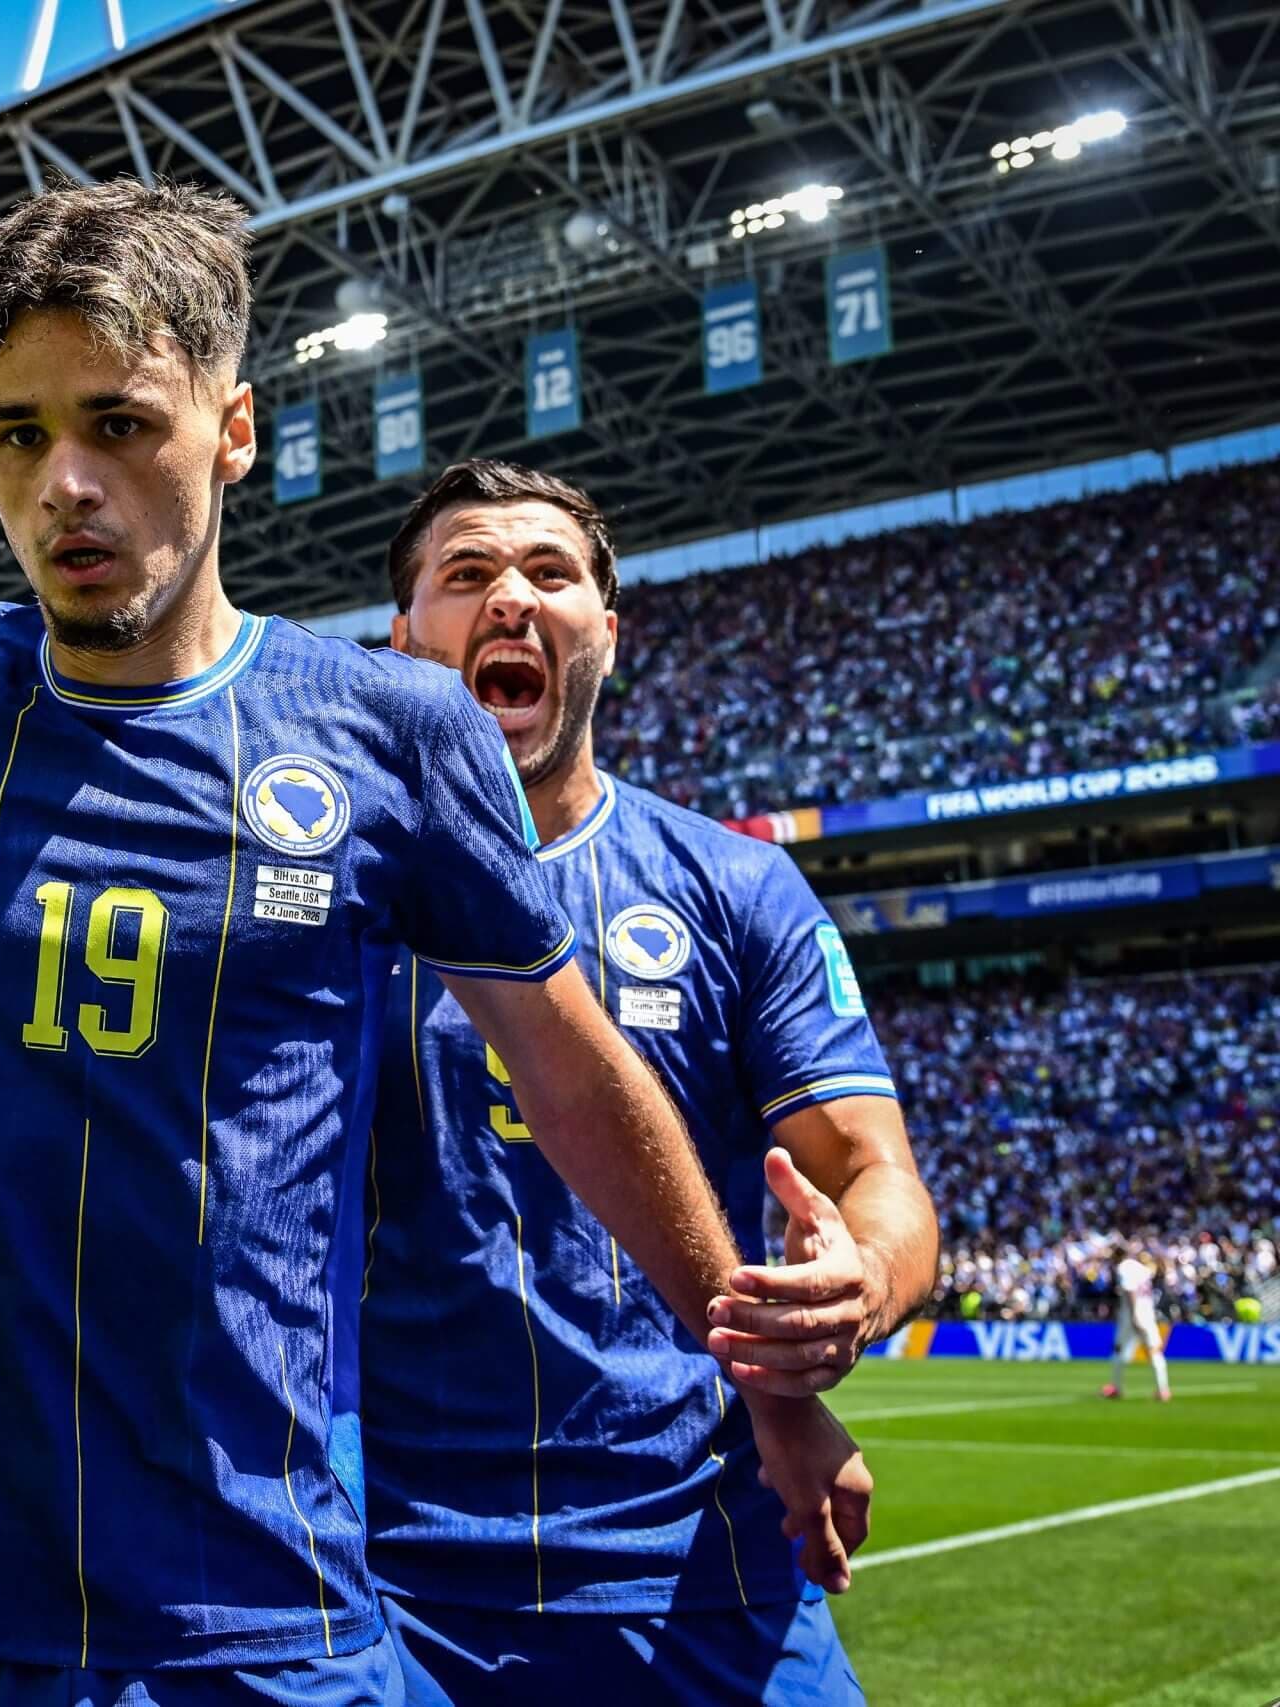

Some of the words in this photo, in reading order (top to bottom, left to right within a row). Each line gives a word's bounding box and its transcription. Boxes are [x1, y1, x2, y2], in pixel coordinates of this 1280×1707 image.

[835, 288, 881, 337] 71
[707, 320, 757, 368] 96
[533, 368, 572, 411] 12
[275, 436, 318, 480] 45
[926, 790, 980, 820] FIFA
[980, 777, 1069, 812] WORLD
[1070, 769, 1121, 799] CUP
[1123, 755, 1218, 791] 2026
[273, 869, 288, 881] BIH
[303, 874, 319, 885] QAT
[303, 892, 319, 904] USA
[263, 904, 276, 916] 24
[277, 907, 300, 919] June
[300, 910, 320, 922] 2026
[22, 881, 170, 1058] 19
[968, 1321, 1071, 1360] VISA
